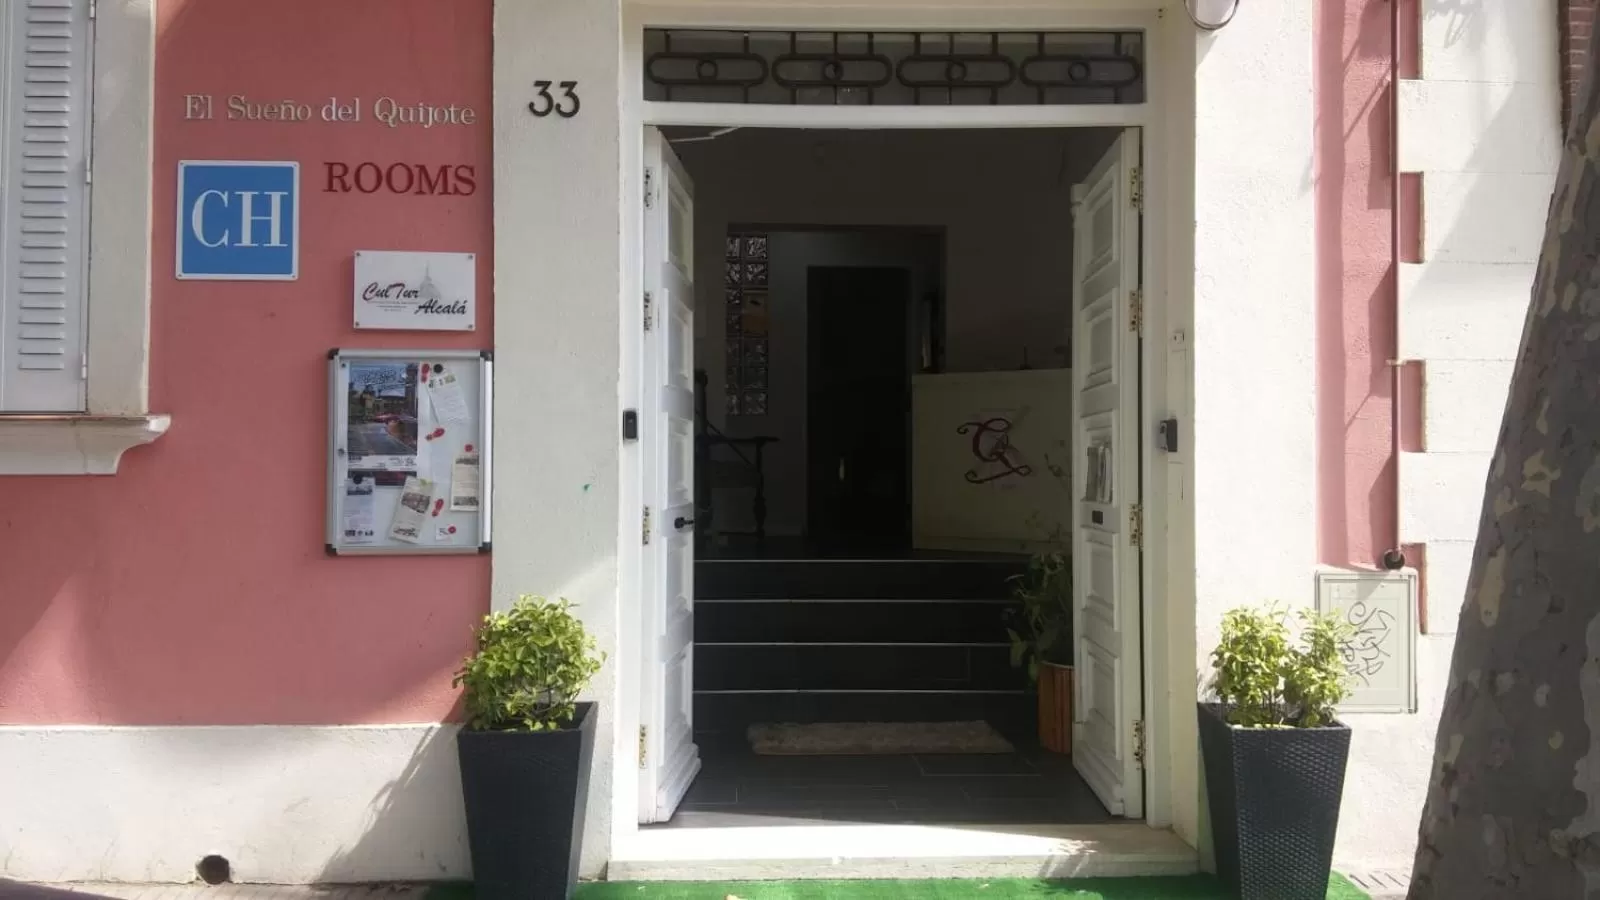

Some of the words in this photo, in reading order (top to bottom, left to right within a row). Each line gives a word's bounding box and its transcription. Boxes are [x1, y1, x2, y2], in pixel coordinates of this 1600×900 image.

[184, 94, 213, 121] El
[227, 95, 312, 122] Sueño
[321, 97, 360, 122] del
[374, 97, 476, 129] Quijote
[529, 80, 580, 118] 33
[323, 162, 476, 196] ROOMS
[191, 189, 289, 248] CH
[413, 298, 468, 316] Alcalá
